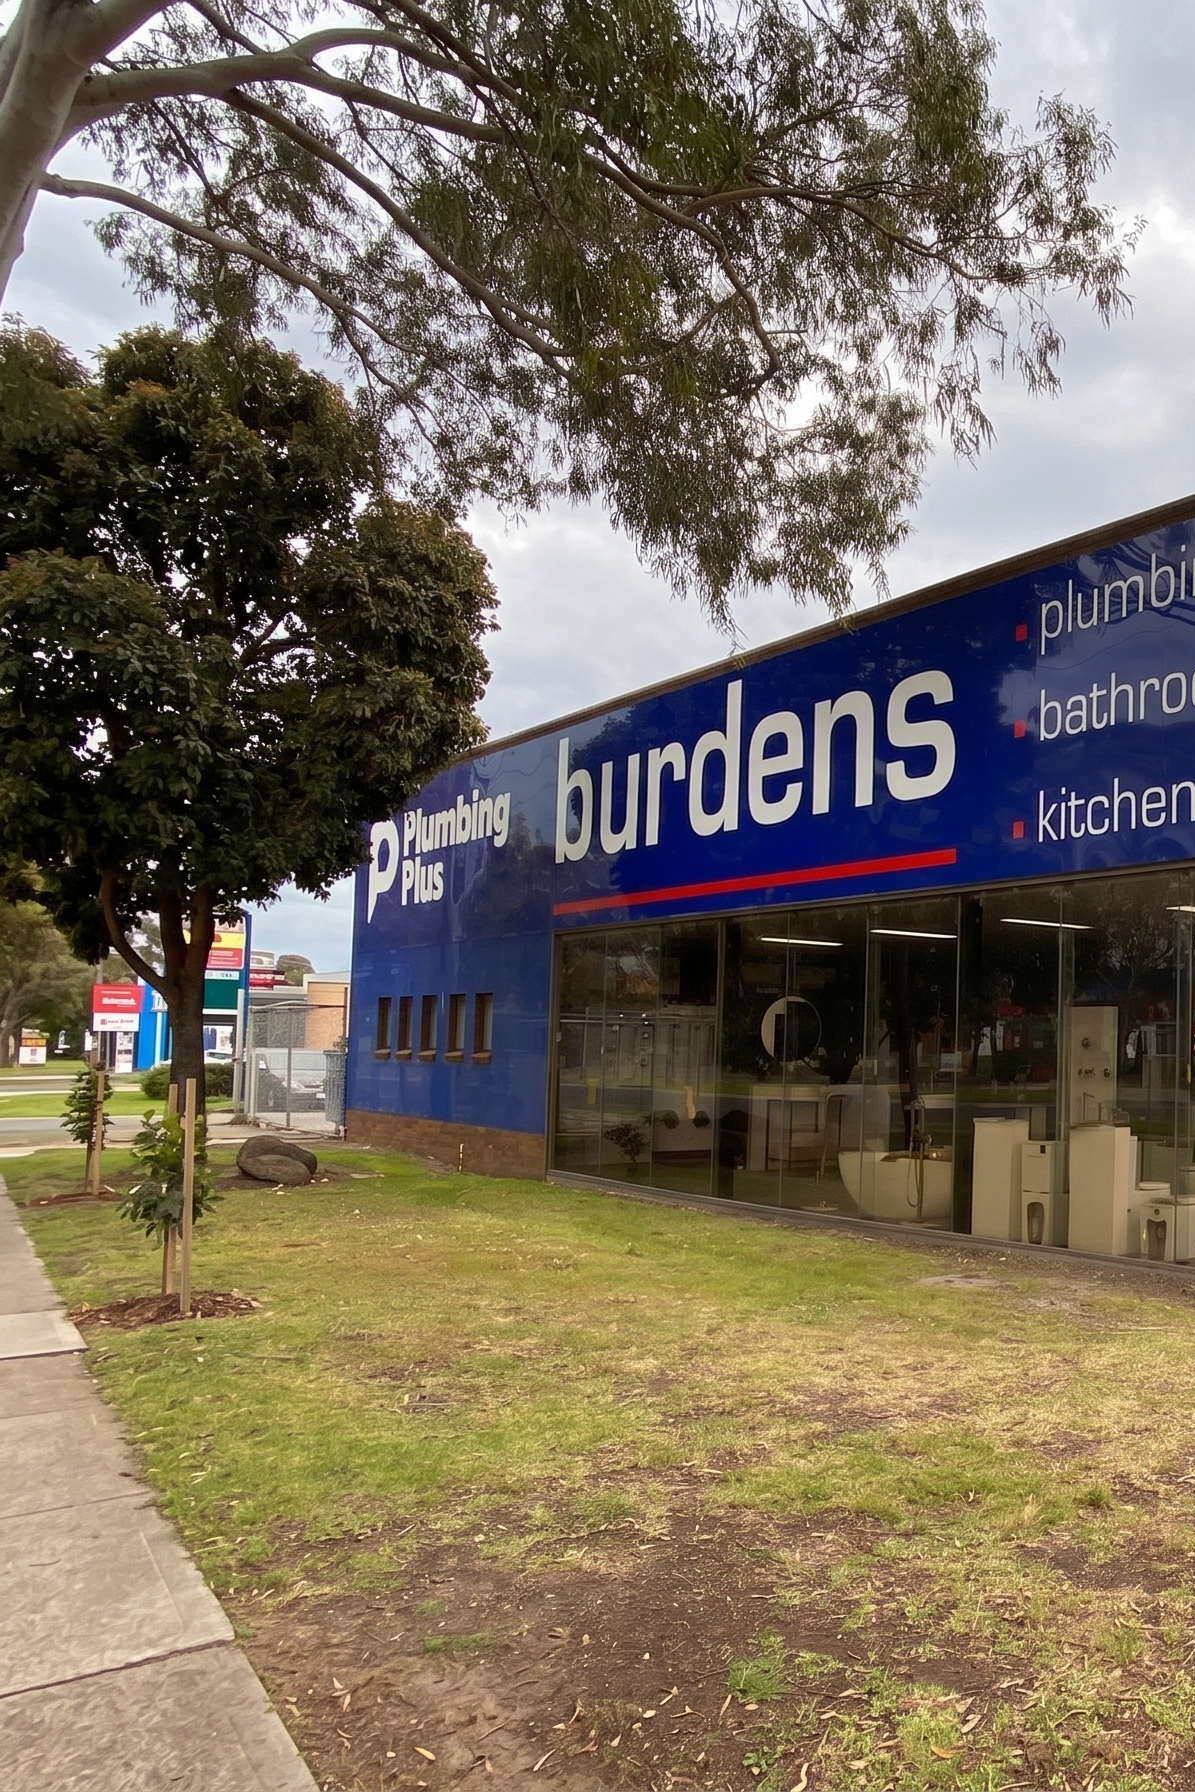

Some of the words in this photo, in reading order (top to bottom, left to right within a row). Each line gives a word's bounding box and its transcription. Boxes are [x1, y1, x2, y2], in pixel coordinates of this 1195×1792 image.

[555, 669, 957, 864] burdens
[403, 788, 511, 857] Plumbing
[401, 856, 444, 906] Plus
